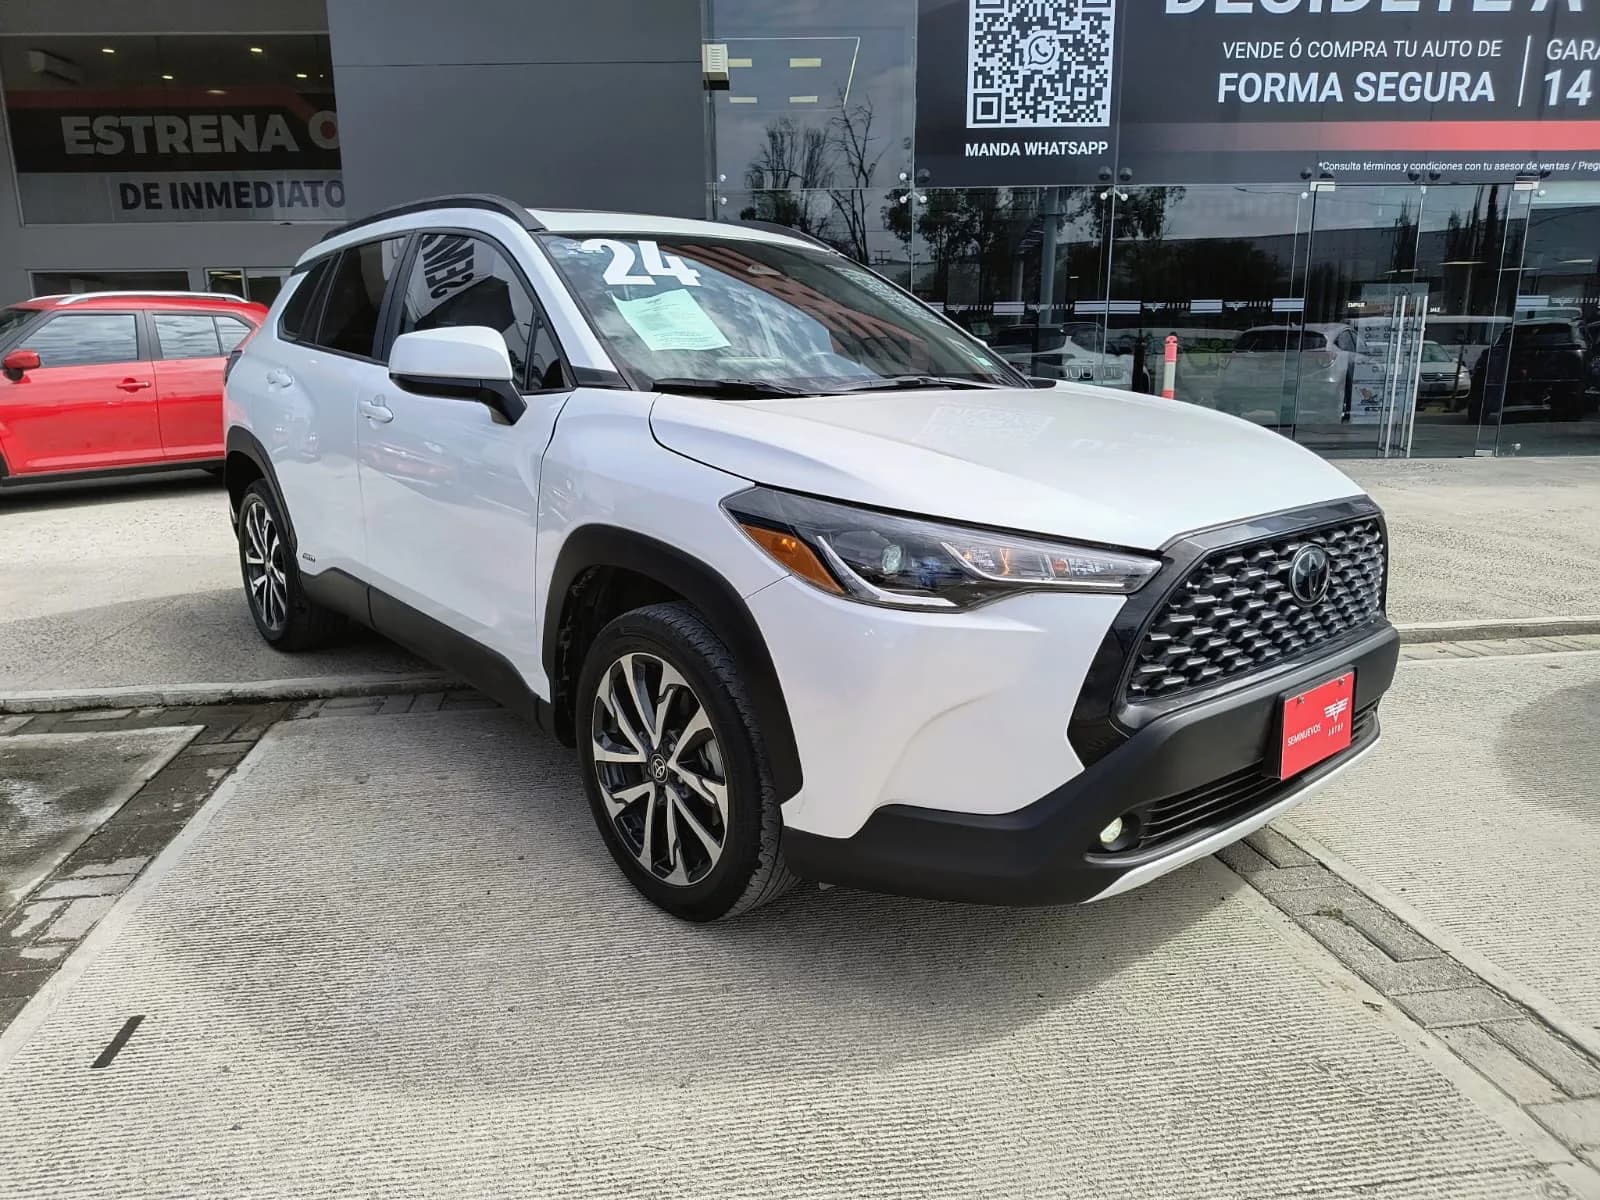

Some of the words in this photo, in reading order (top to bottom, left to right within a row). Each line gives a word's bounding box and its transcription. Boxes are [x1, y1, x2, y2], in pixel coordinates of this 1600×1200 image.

[1223, 41, 1284, 59] VENDE
[1289, 37, 1302, 59] Ó
[1307, 41, 1388, 58] COMPRA
[1394, 40, 1417, 57] TU
[1421, 40, 1472, 57] AUTO
[1477, 40, 1503, 57] DE
[1217, 71, 1344, 103] FORMA
[1354, 71, 1496, 102] SEGURA
[1544, 69, 1592, 106] 14
[61, 114, 300, 154] ESTRENA
[965, 143, 1020, 157] MANDA
[1025, 141, 1108, 155] WHATSAPP
[1363, 161, 1401, 171] términos
[1402, 162, 1408, 173] y
[1409, 161, 1463, 171] condiciones
[1464, 163, 1481, 171] con
[1483, 162, 1493, 171] tu
[1494, 162, 1524, 171] asesor
[1526, 161, 1538, 171] de
[1539, 162, 1570, 171] ventas
[119, 182, 162, 210] DE
[169, 180, 345, 209] INMEDIATO
[581, 239, 702, 286] 24
[1287, 722, 1321, 747] SEMINUEVOS
